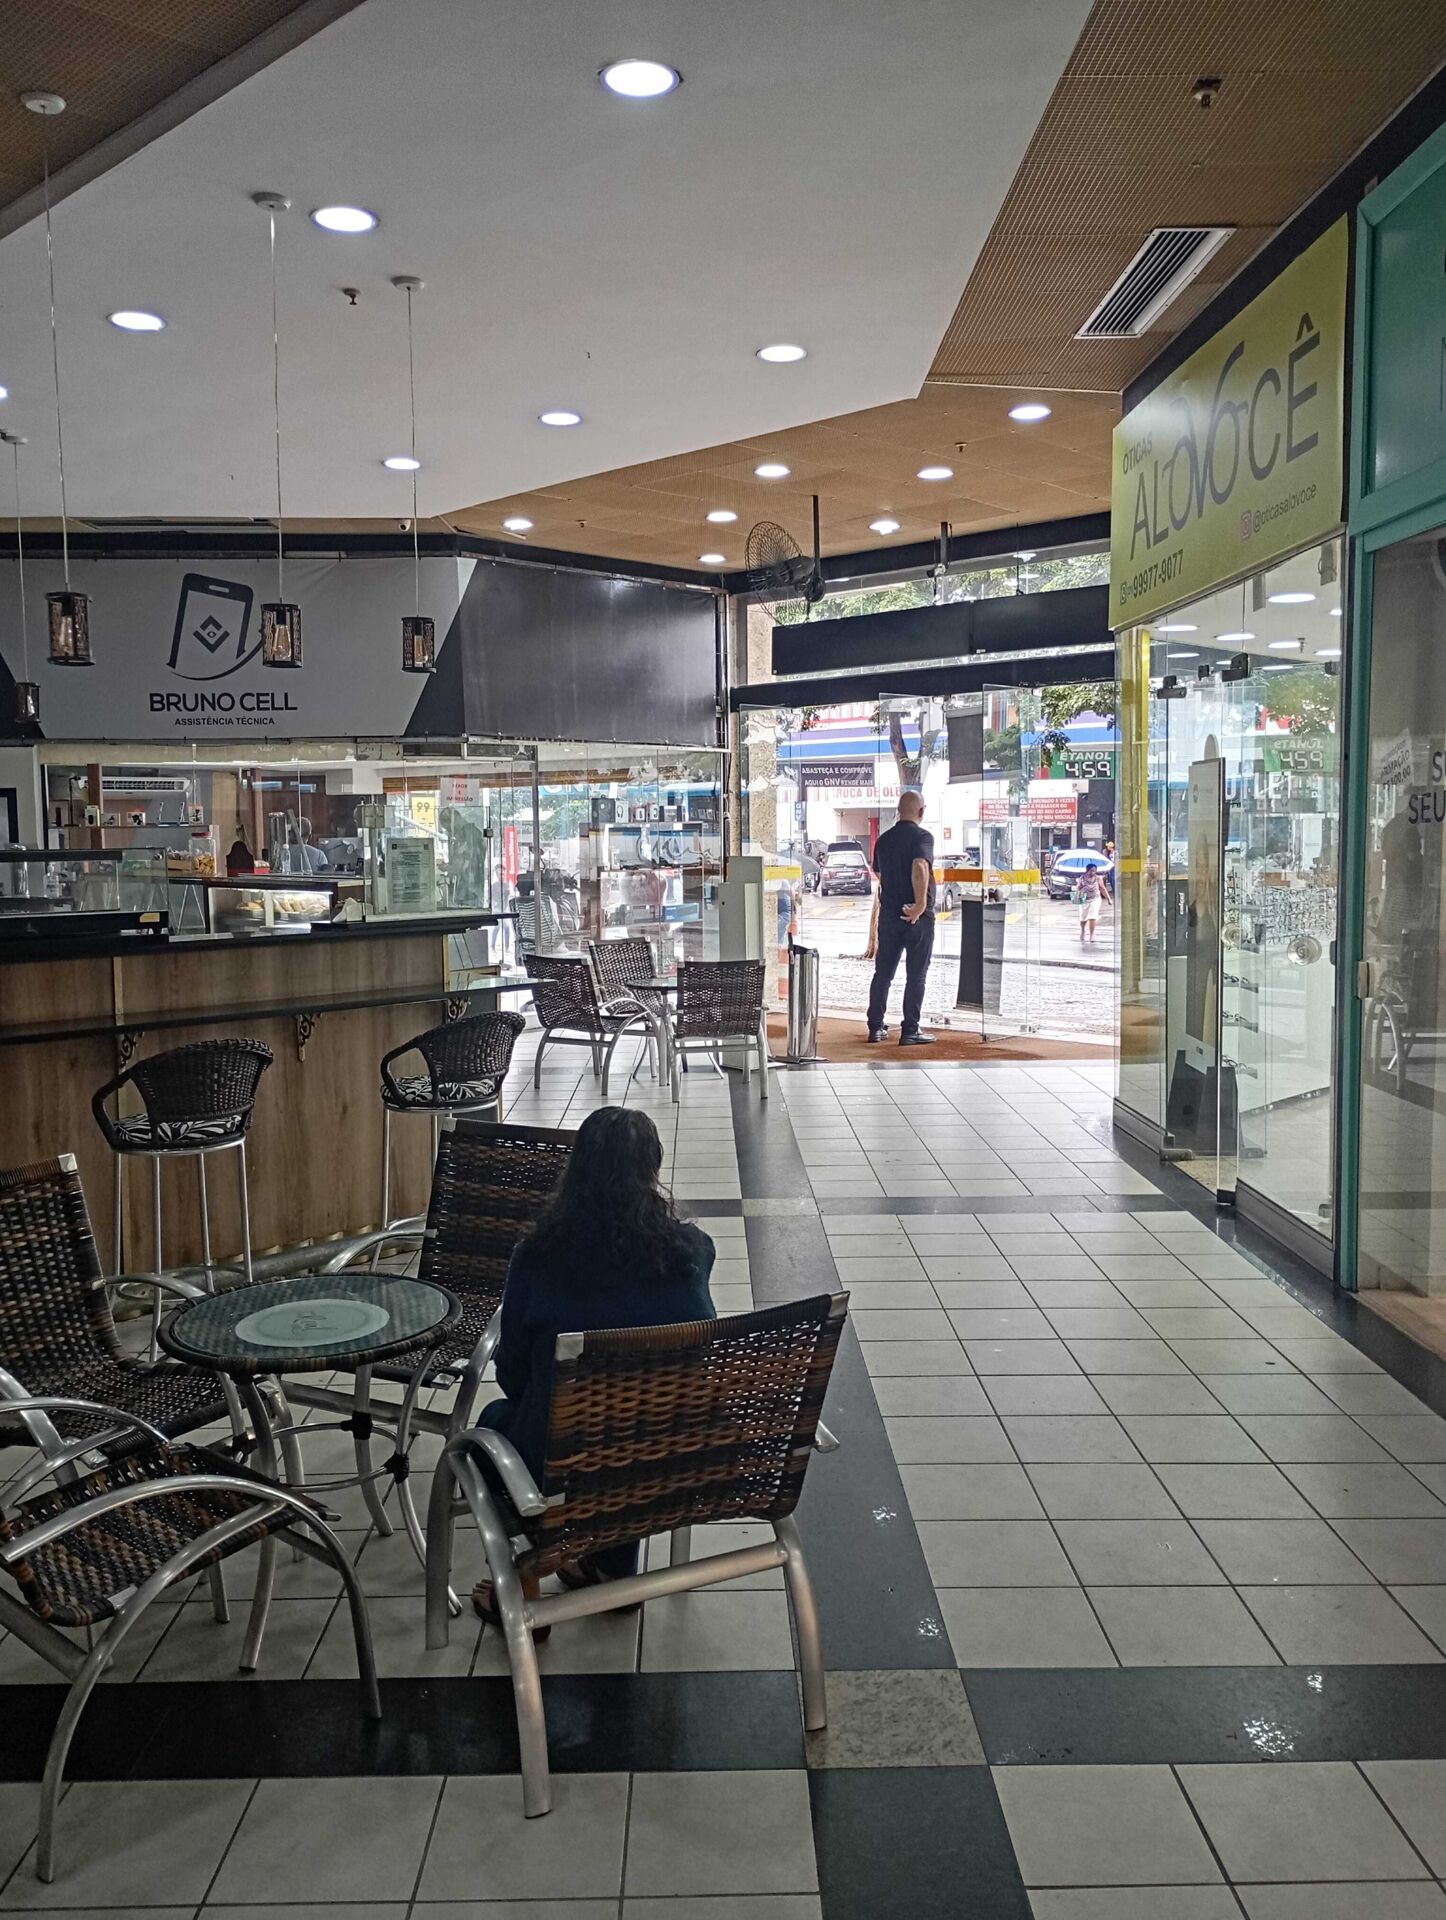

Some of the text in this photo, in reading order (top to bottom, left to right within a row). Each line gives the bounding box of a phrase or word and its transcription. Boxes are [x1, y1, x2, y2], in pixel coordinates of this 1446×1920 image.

[1122, 431, 1153, 475] ÓTICAS
[1253, 483, 1317, 533] @oticasalovoce
[1133, 548, 1184, 599] 99977-9077
[149, 692, 298, 712] BRUNO CELL
[174, 715, 275, 726] ASSISTÊNCIA TÉCNICA
[1059, 751, 1111, 761] ETANOL
[802, 767, 834, 775] ABASTEÇA
[840, 766, 873, 774] COMPROVE
[824, 777, 841, 786] GNV
[866, 787, 880, 798] DE
